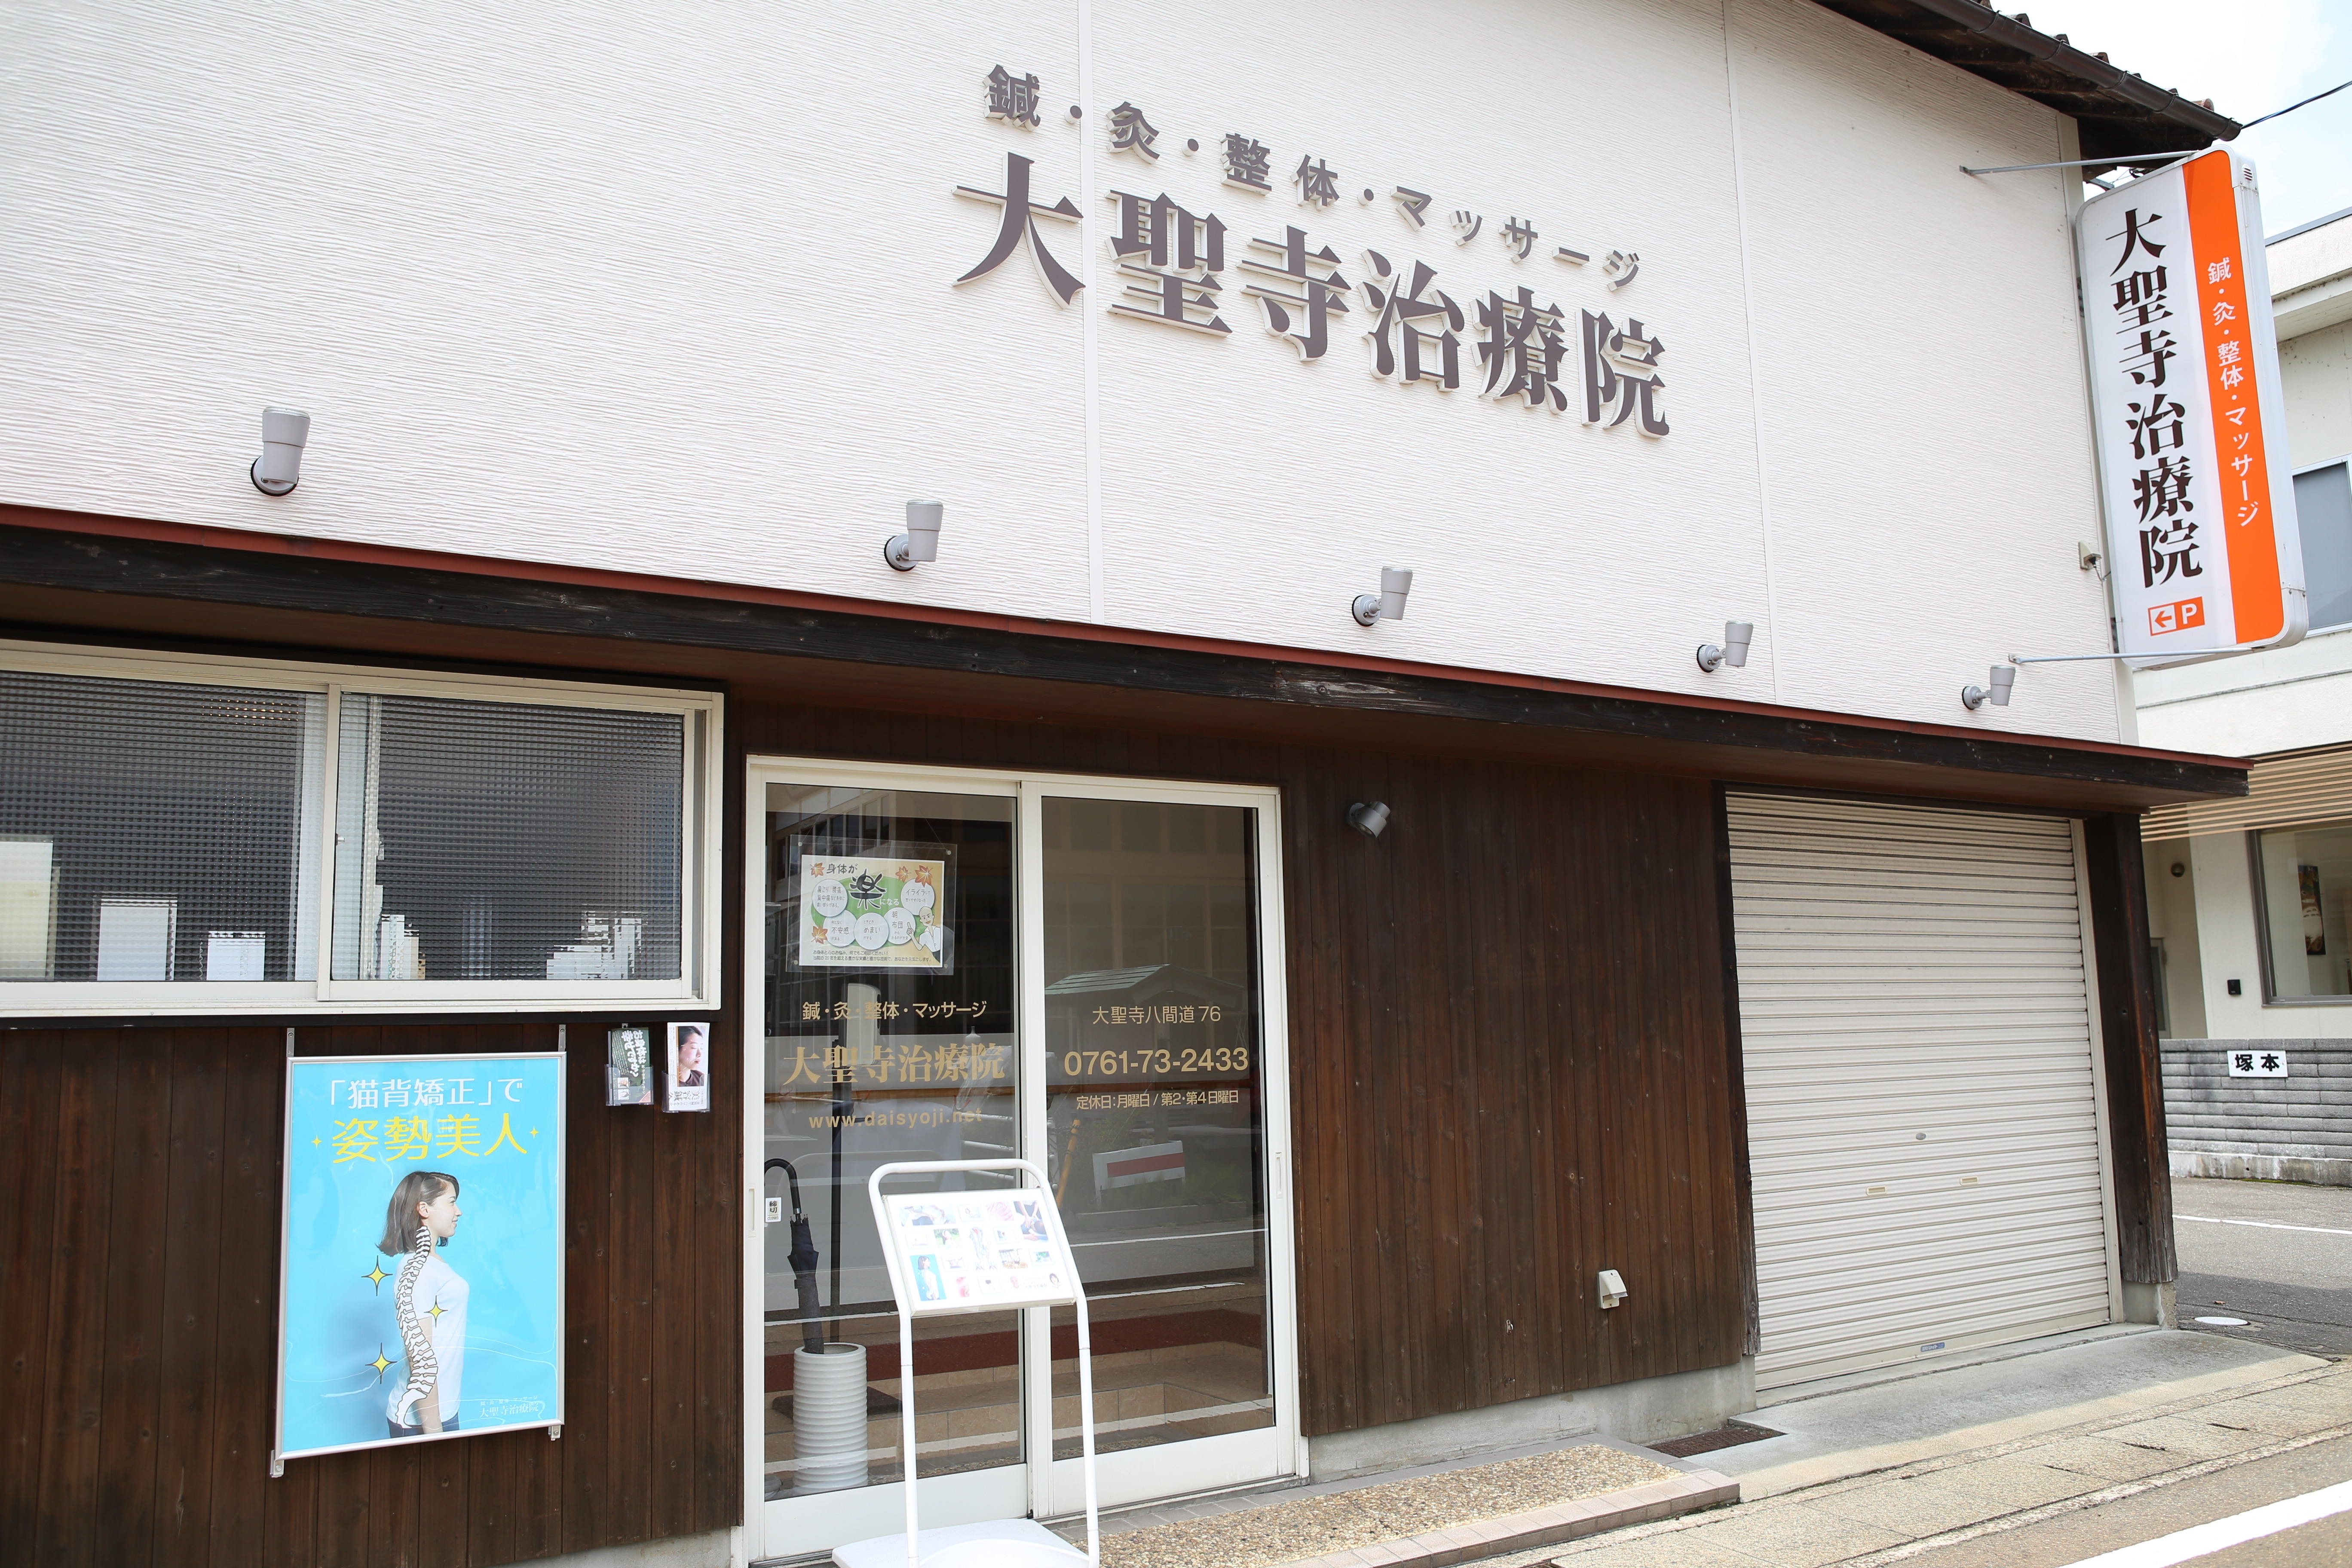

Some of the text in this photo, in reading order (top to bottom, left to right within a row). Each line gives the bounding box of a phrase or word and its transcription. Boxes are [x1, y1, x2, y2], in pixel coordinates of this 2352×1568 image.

[983, 64, 1640, 292] 鍼・灸・整体・マッサージ
[951, 151, 1669, 438] 大聖寺治療院
[2105, 207, 2203, 588] 大聖寺治療院
[2207, 256, 2259, 527] 鍼・灸・整体・マッサージ
[2181, 603, 2197, 625] P
[827, 863, 858, 874] 身体が
[849, 867, 886, 910] 楽
[831, 927, 850, 935] 不安感
[802, 1001, 987, 1020] 鍼・灸・整体・マッサージ
[633, 1030, 647, 1064] お身体は
[1064, 1047, 1249, 1076] 0761-73-2433
[783, 1043, 1005, 1086] 大聖寺治療院
[2235, 1054, 2280, 1072] 塚本
[331, 1078, 523, 1109] 「猫背矯正」で
[808, 1108, 982, 1128] www.daisyoji.net
[332, 1113, 527, 1163] 姿勢美人
[769, 1200, 778, 1213] 締切
[479, 1402, 539, 1418] 大聖寺治療院
